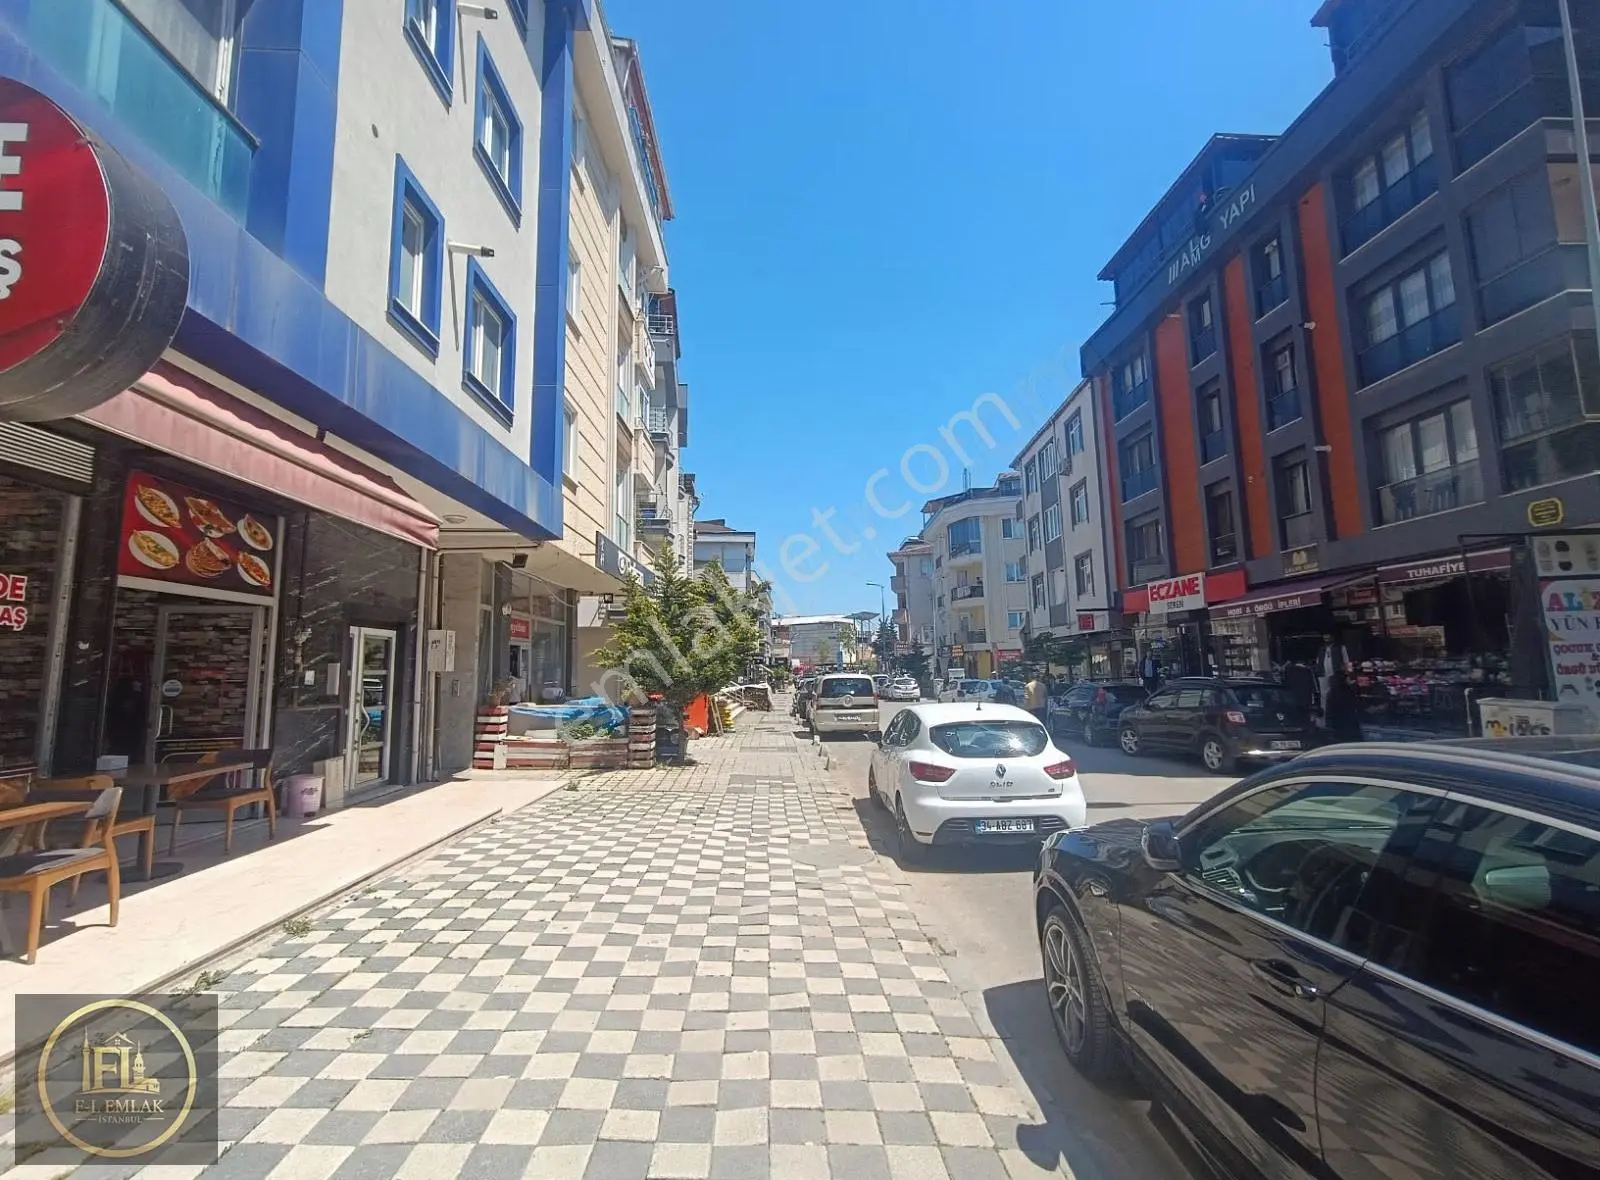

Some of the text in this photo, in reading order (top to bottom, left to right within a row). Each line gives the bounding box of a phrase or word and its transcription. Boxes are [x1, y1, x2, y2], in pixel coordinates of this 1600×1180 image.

[1219, 183, 1256, 230] YAPI
[1407, 561, 1465, 578] TUHAFİYE
[1149, 576, 1200, 601] ECZANE
